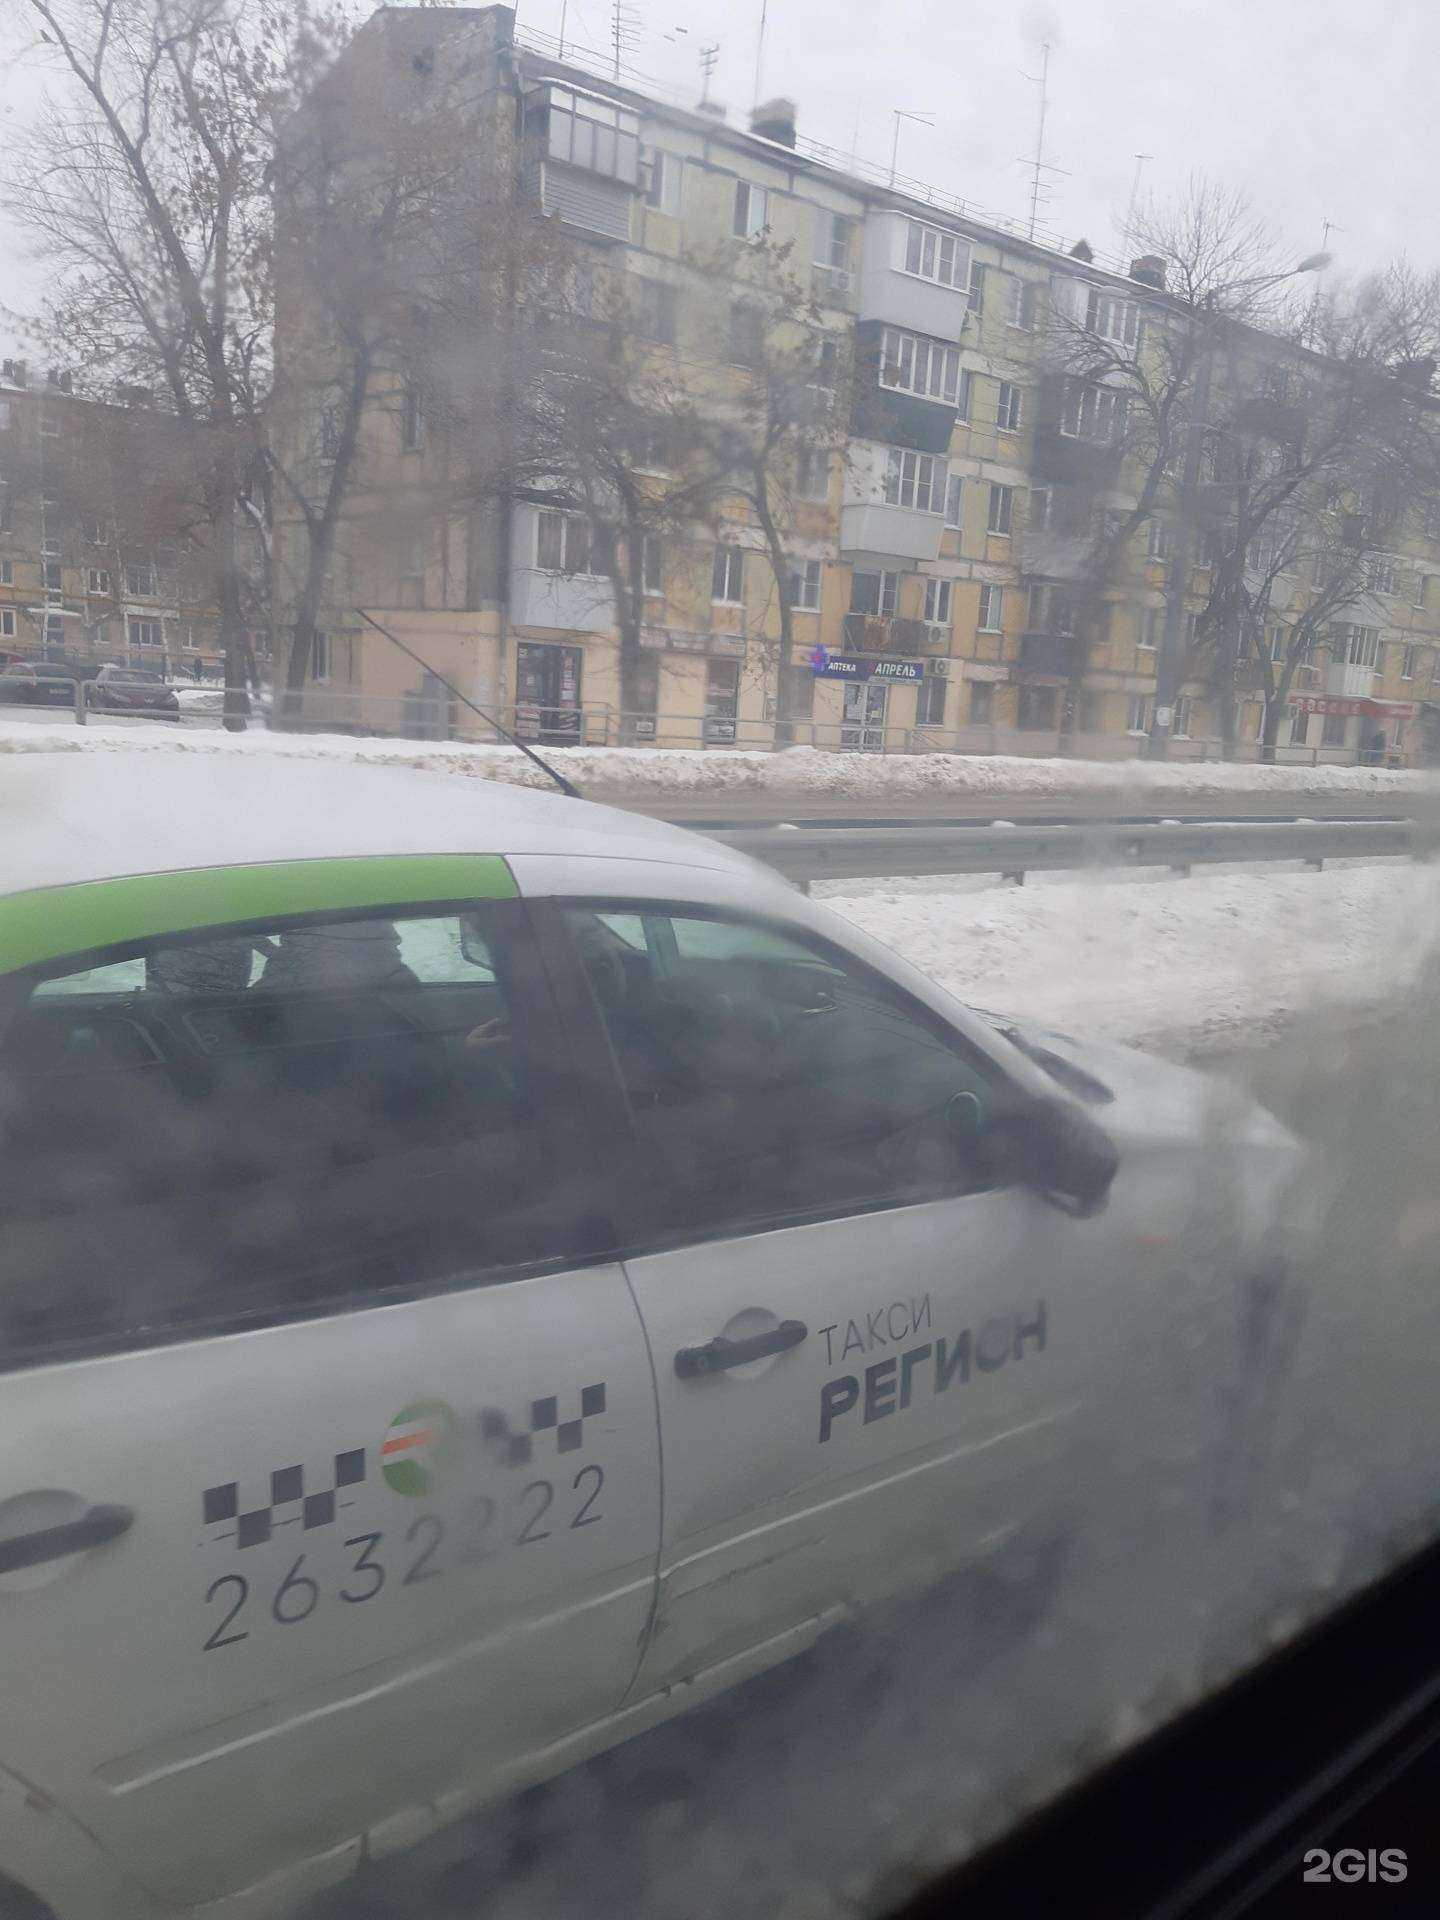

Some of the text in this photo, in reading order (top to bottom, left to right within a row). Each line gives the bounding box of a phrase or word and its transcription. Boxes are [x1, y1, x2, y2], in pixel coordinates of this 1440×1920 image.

[828, 662, 916, 677] АПТЕКА АПРЕЛЬ
[818, 1293, 932, 1366] ТАКСИ
[818, 1299, 1047, 1444] РЕГИОН
[203, 1464, 605, 1651] 2632222
